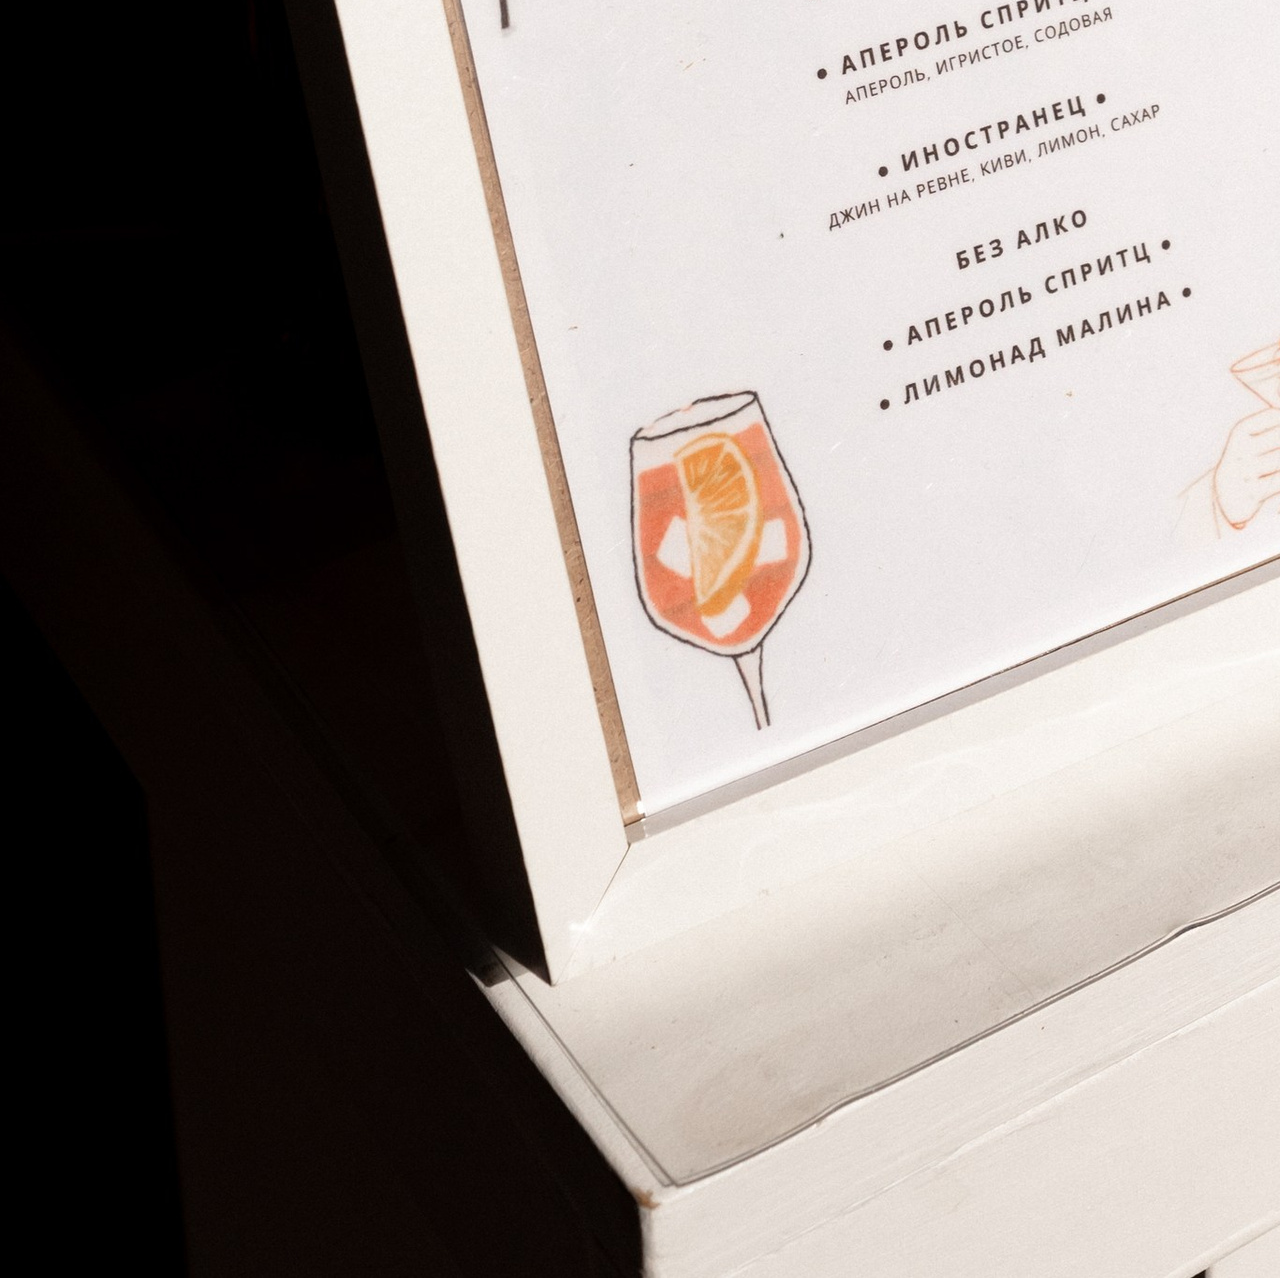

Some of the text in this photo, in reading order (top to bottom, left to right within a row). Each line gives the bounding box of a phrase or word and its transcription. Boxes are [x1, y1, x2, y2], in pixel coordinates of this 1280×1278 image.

[840, 19, 969, 77] АПЕРОЛЬ
[844, 5, 1114, 106] АПЕРОЛЬ, ИГРИСТОЕ, СОДОВАЯ
[827, 103, 1161, 233] ДЖИН НА РЕВНЕ, КИВИ, ЛИМОН, САХАР
[899, 94, 1088, 173] ИНОСТРАНЕЦ
[954, 208, 1089, 272] БЕЗ АЛКО
[906, 241, 1153, 347] АПЕРОЛЬ СПРИТЦ
[902, 289, 1173, 406] ЛИМОНАД МАЛИНА
